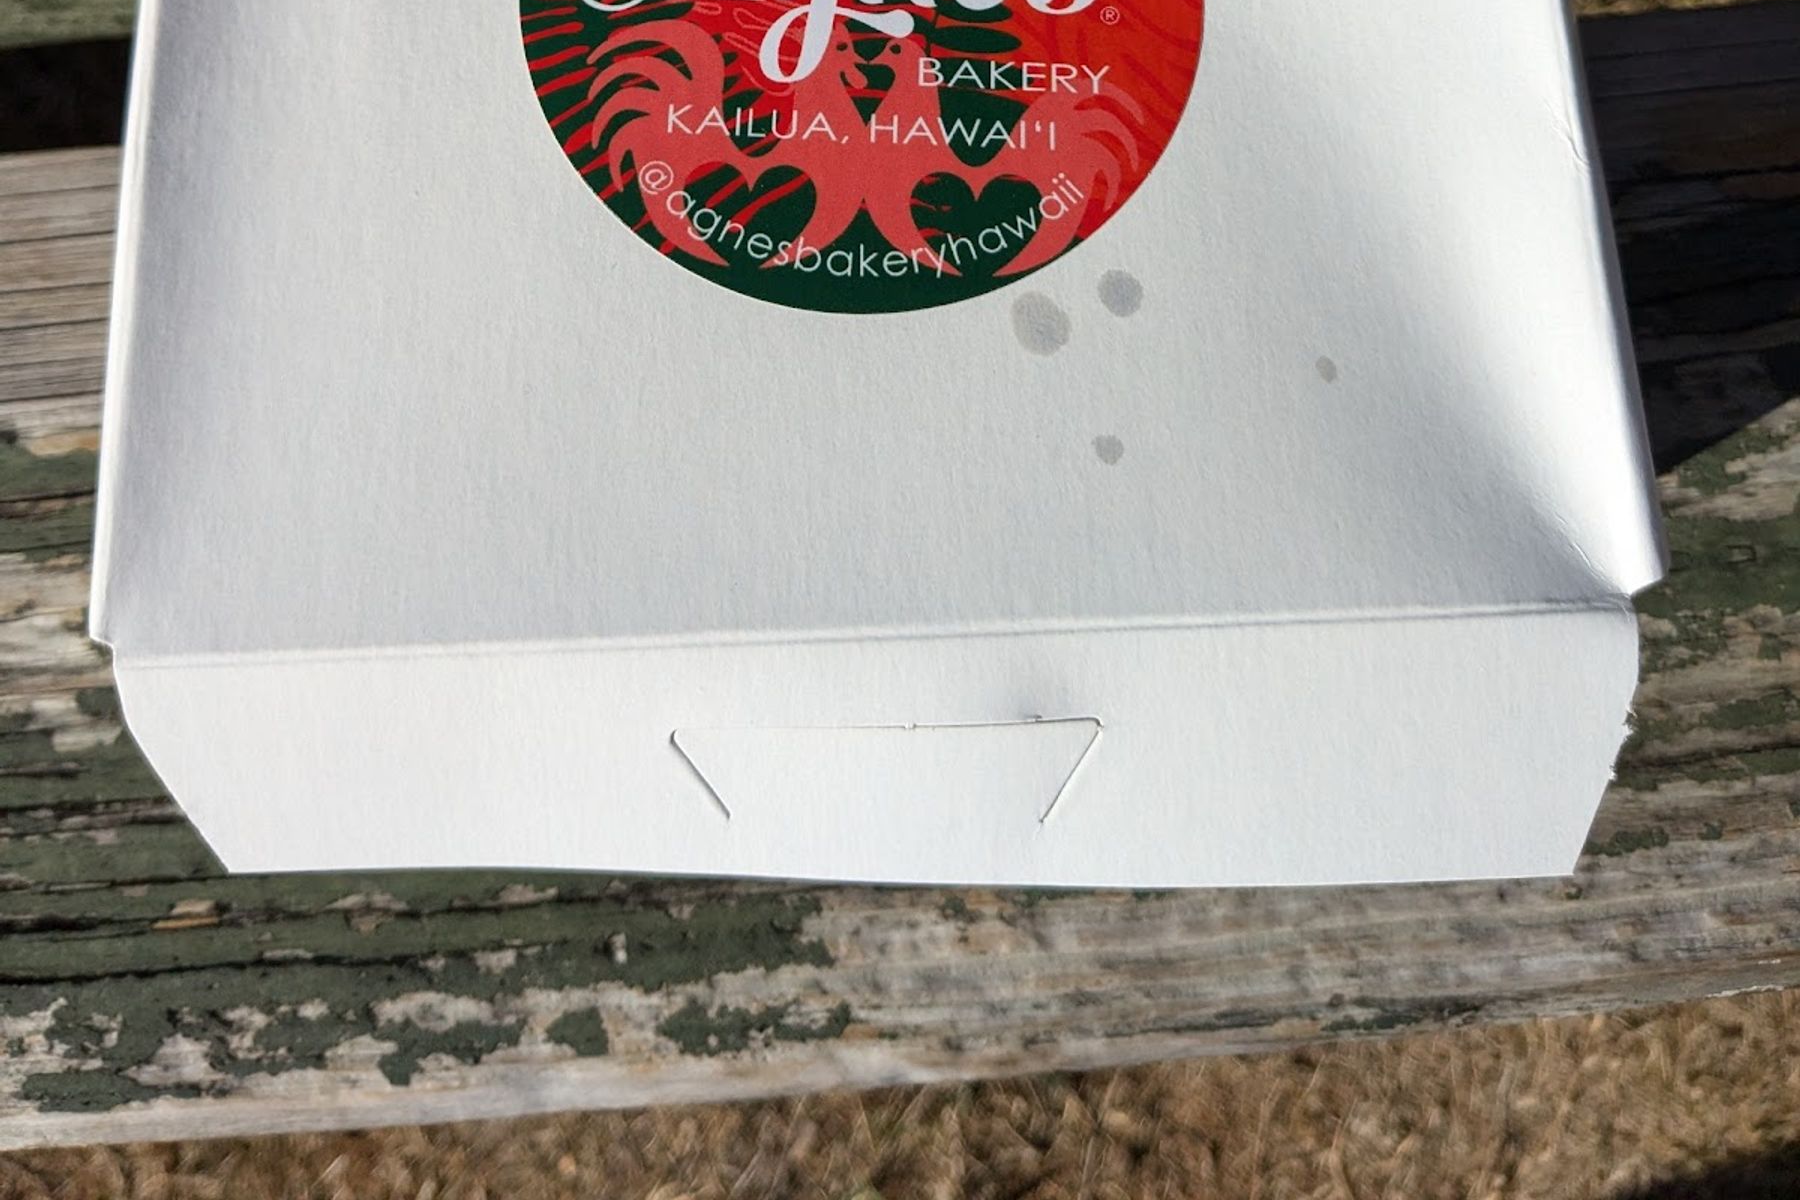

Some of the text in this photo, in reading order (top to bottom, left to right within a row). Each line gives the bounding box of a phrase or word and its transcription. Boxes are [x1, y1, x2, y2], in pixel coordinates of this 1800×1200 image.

[918, 57, 1110, 94] BAKERY
[666, 103, 849, 144] KAILUA,
[638, 160, 1085, 278] @agnesbakeryhawaii
